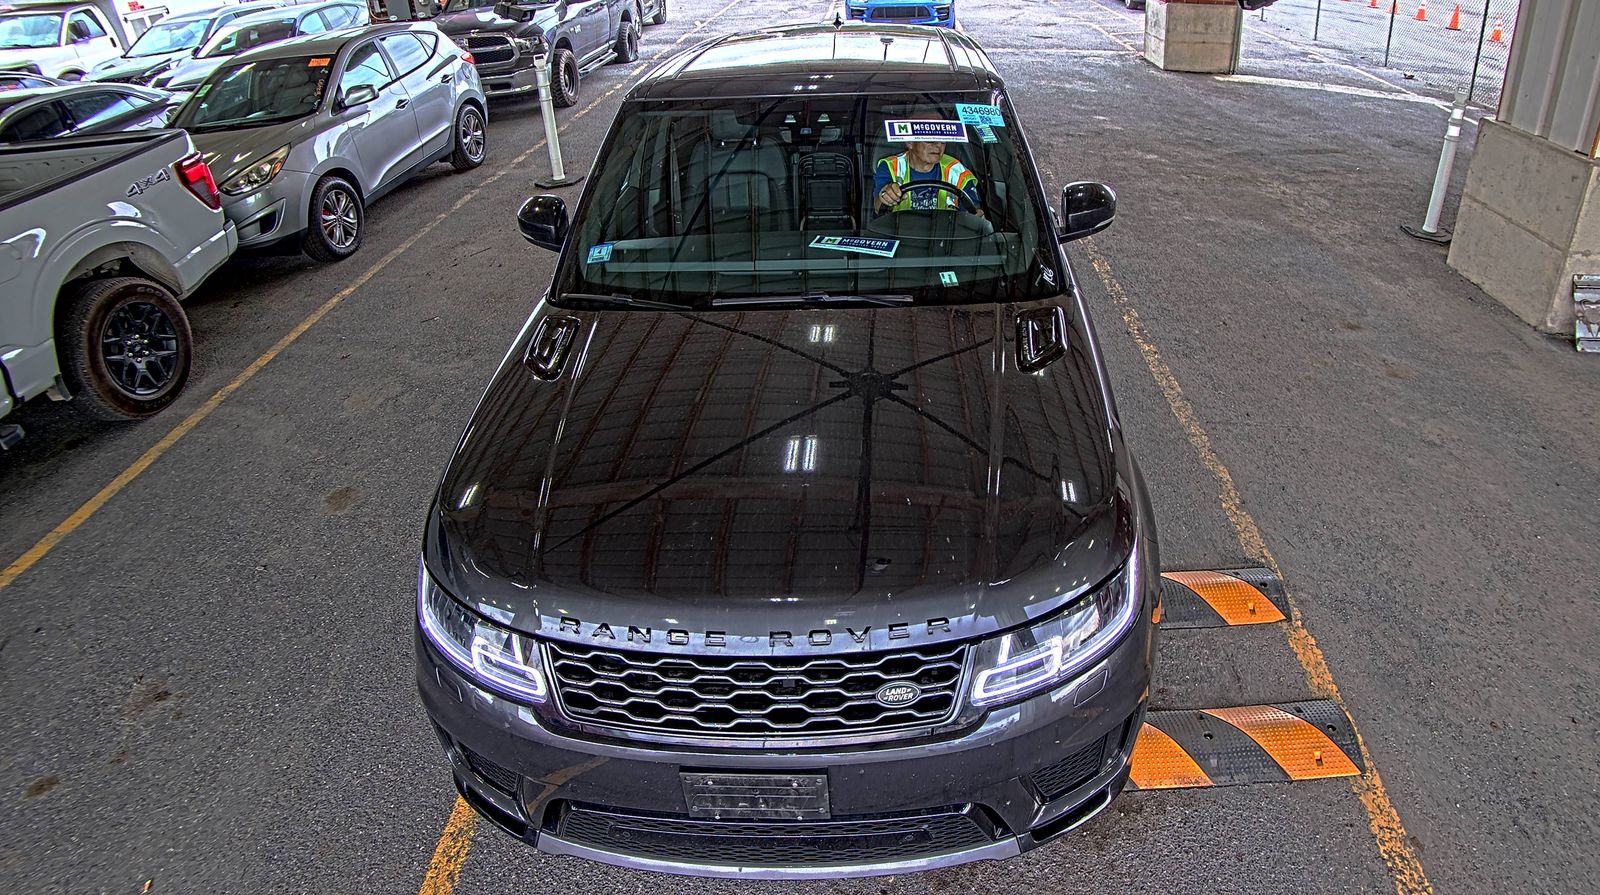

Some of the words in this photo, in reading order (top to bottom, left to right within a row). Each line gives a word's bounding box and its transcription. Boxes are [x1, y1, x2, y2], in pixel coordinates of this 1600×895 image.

[962, 106, 1001, 116] 4346980
[897, 124, 909, 134] M
[559, 615, 727, 647] RANGE
[768, 615, 952, 648] ROVER
[885, 687, 907, 696] LAND
[887, 693, 914, 702] ROVER
